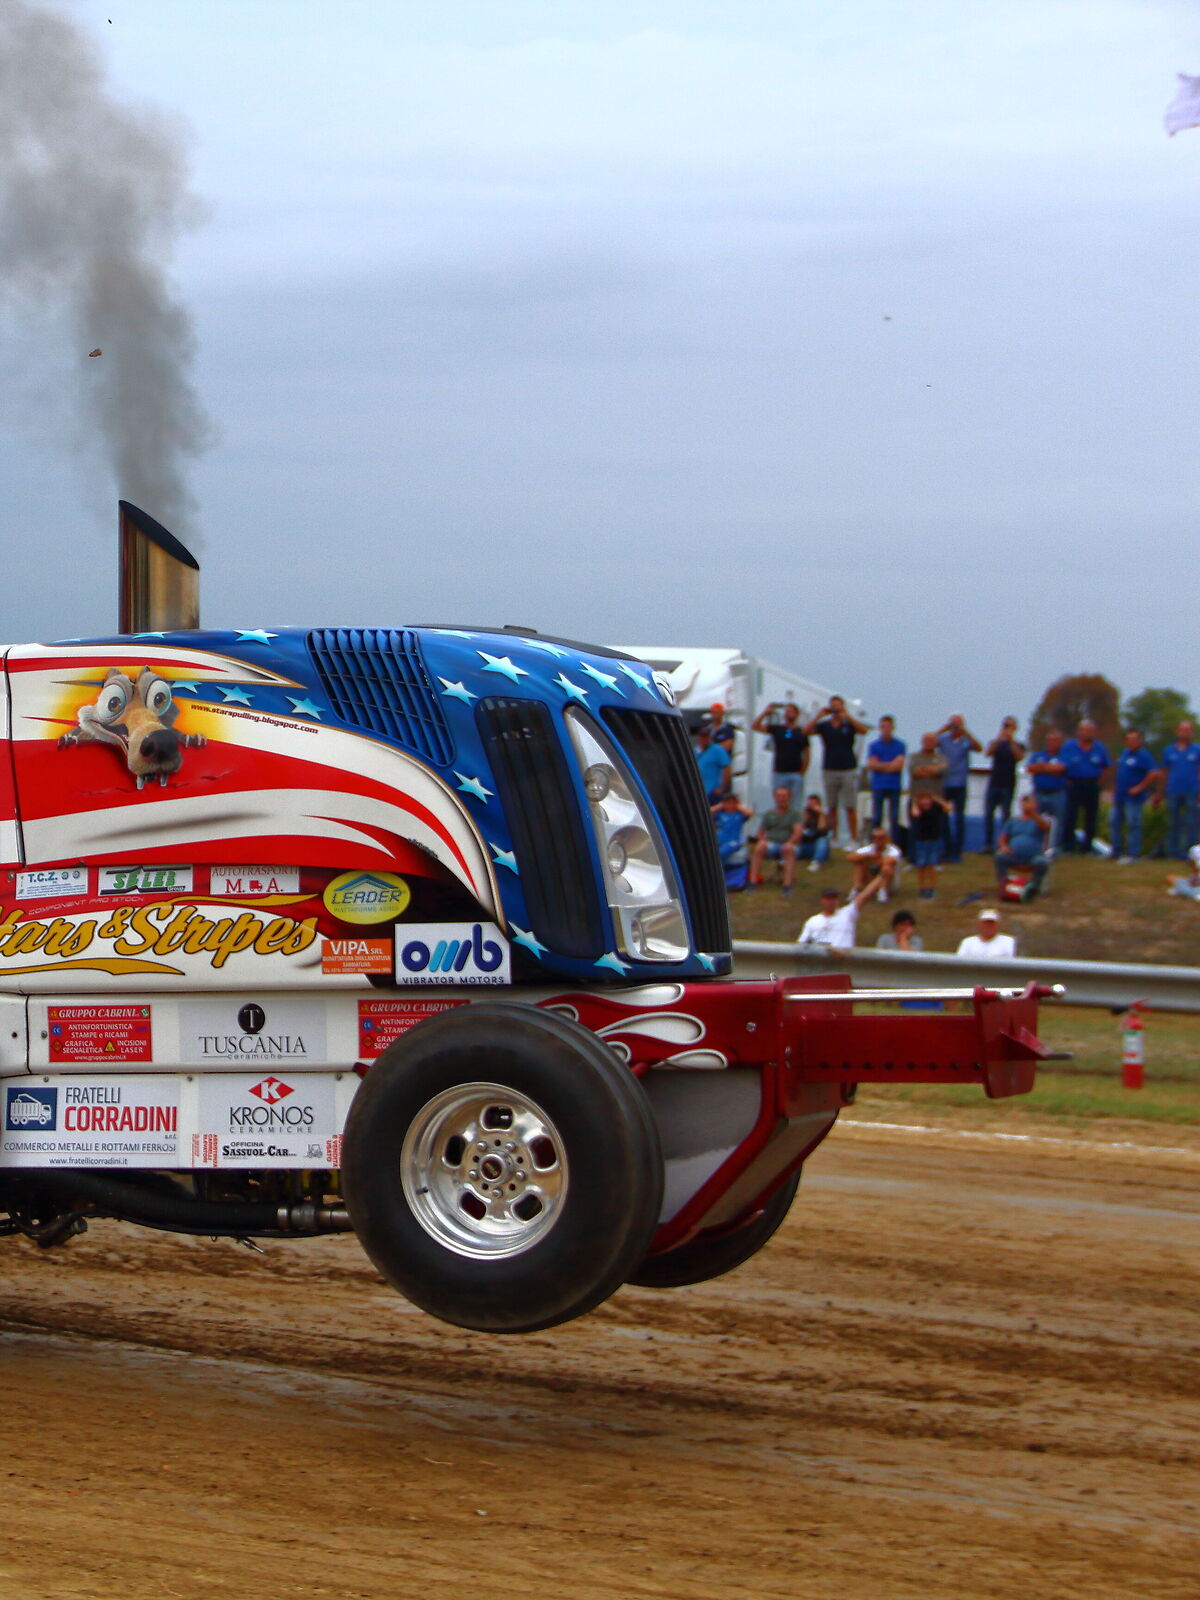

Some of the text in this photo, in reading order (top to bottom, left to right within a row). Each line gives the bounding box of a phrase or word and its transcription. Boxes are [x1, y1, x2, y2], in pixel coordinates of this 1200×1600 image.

[191, 703, 319, 734] www.starspulling.blogspot.com
[28, 871, 58, 883] T.C.Z.
[212, 865, 299, 877] AUTOTRASPORTI
[331, 889, 402, 905] LEADER
[99, 904, 136, 939] &
[113, 900, 319, 969] Stripes
[330, 940, 384, 955] VIPA SRL
[402, 976, 505, 985] VIBRATOR MOTORS
[59, 1008, 136, 1018] GRUPPO CABRINI
[370, 1003, 411, 1012] GRUPPO
[243, 1009, 260, 1029] T
[68, 1023, 133, 1031] ANTINFORTUNISTICA
[71, 1031, 97, 1039] STAMPE
[198, 1035, 306, 1054] TUSCANIA
[65, 1087, 121, 1104] FRATELLI
[260, 1081, 281, 1099] K
[64, 1106, 177, 1132] CORRADINI
[230, 1106, 314, 1126] KRONOS
[229, 1126, 312, 1134] CERAMICHE
[4, 1142, 176, 1152] COMMERCIO METALLI E ROTTAMI FERROSI
[49, 1156, 128, 1165] www.fratellicorradini.it
